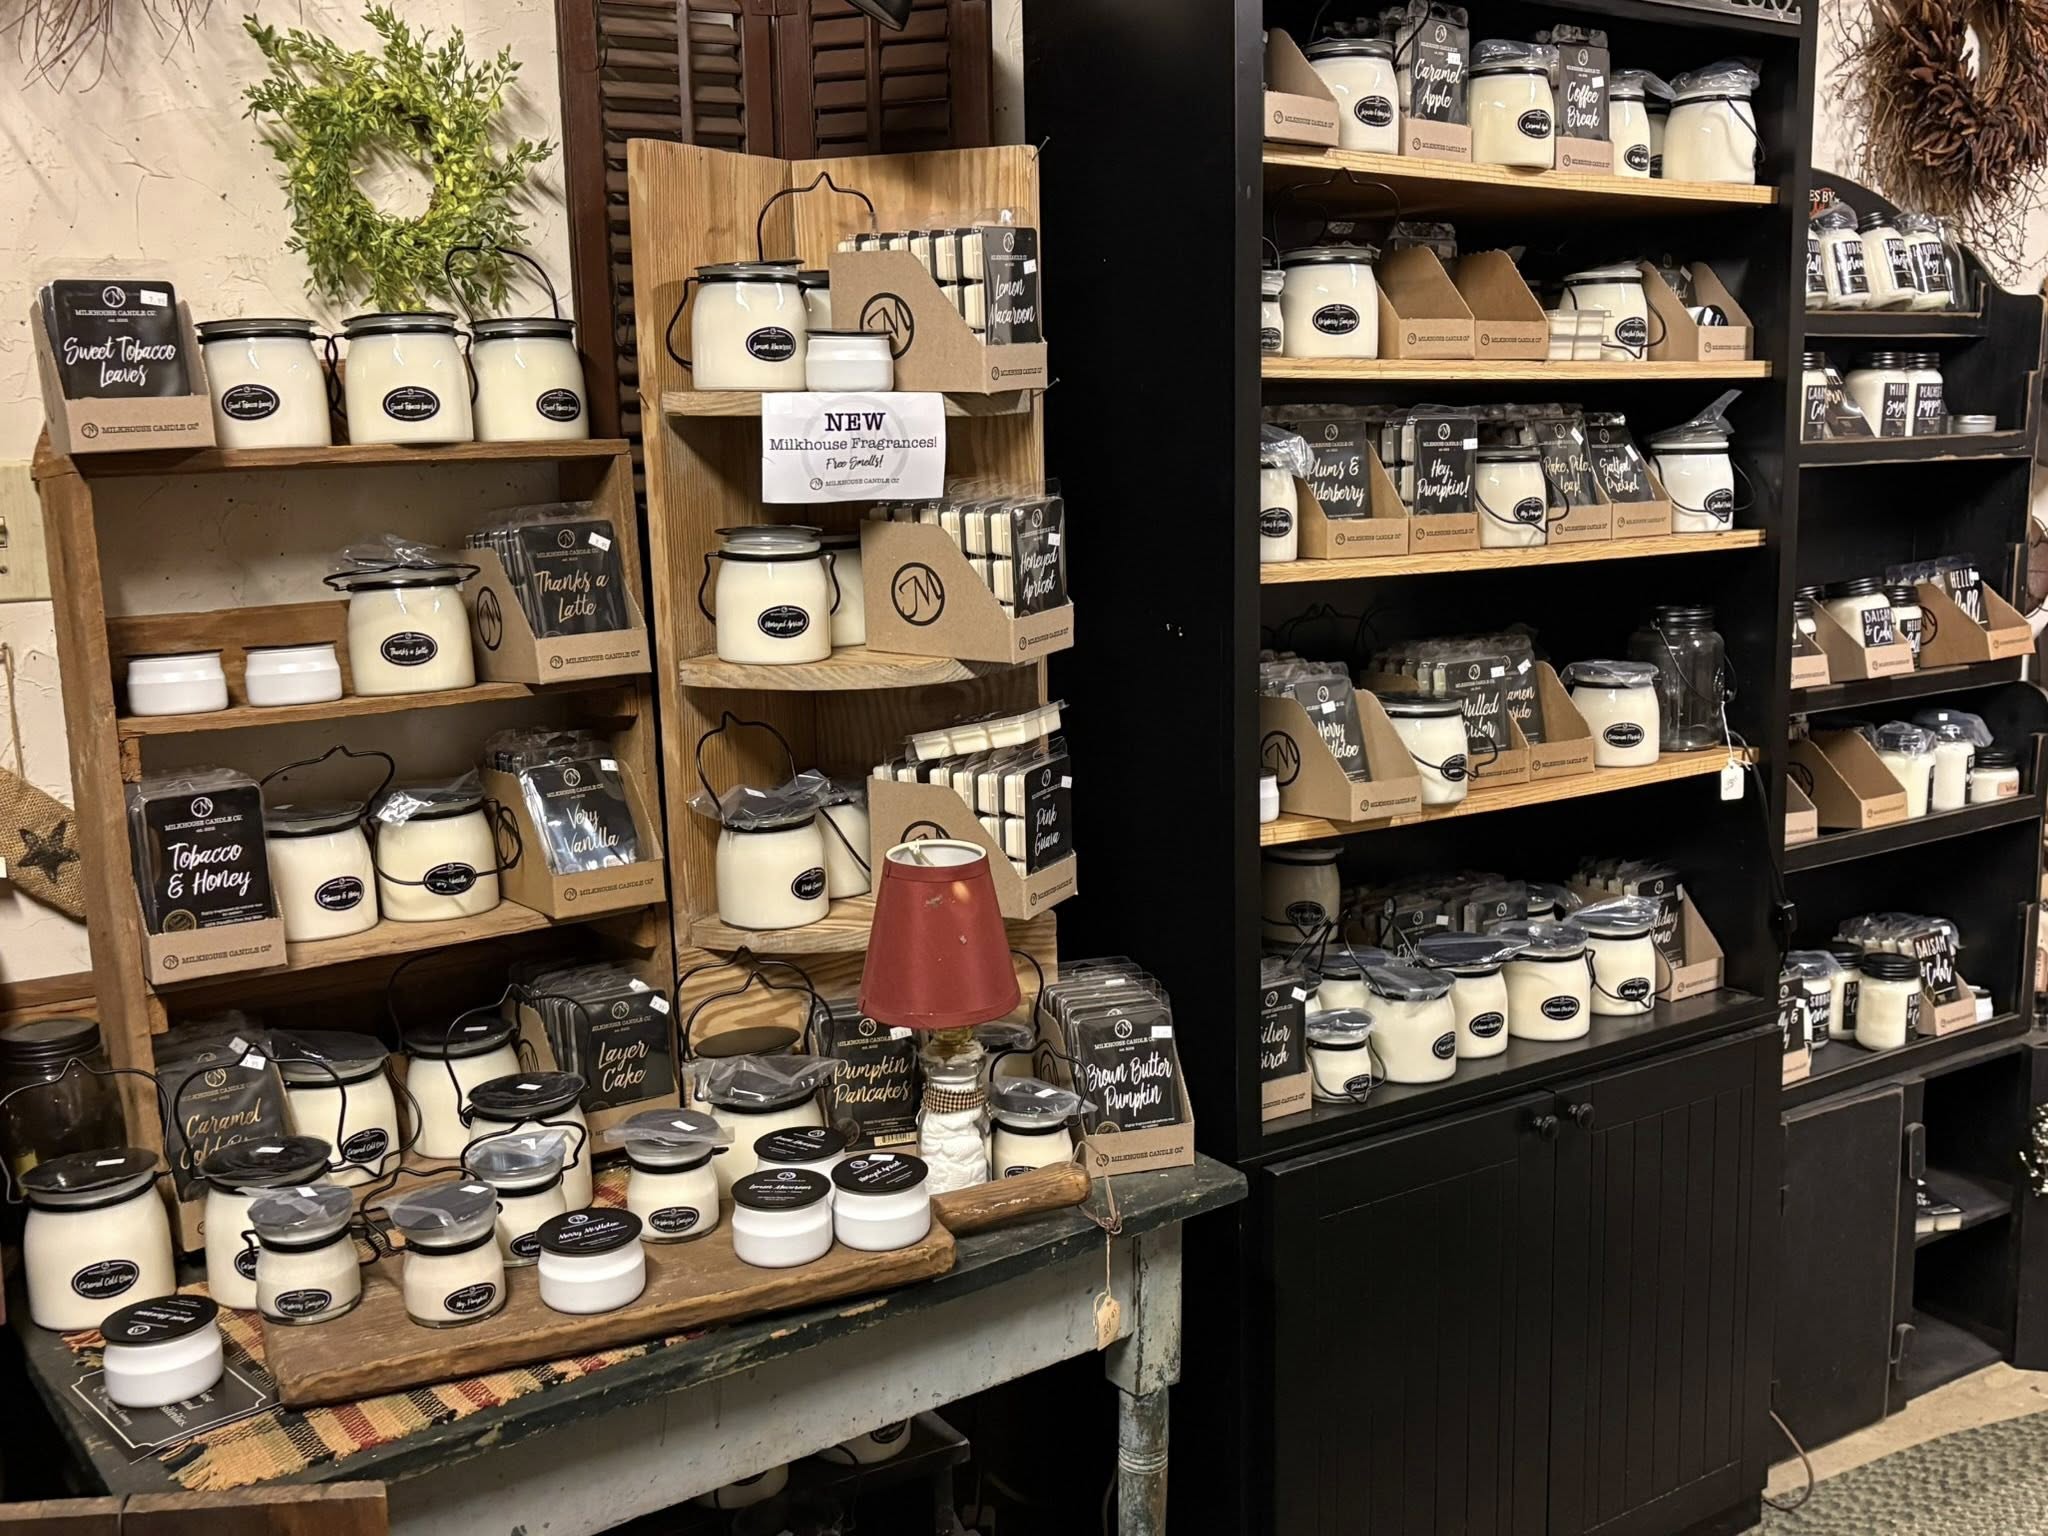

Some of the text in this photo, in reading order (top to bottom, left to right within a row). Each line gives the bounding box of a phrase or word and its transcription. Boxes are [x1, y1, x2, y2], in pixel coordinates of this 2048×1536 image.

[1414, 60, 1467, 85] Caramel
[1421, 87, 1452, 114] Apple
[1567, 80, 1599, 110] Coffee
[1567, 107, 1600, 128] Break
[1809, 189, 1821, 201] ES
[995, 273, 1025, 301] Lemon
[991, 303, 1036, 328] Macaroon
[64, 335, 177, 366] Sweet Tobacco
[100, 361, 149, 388] Leaves
[153, 425, 185, 433] CANDLE
[824, 411, 887, 432] NEW
[769, 435, 937, 452] Milkhouse Fragrances!
[825, 453, 884, 470] Free Smells!
[1349, 455, 1361, 477] &
[1432, 458, 1454, 482] Hey,
[1599, 454, 1631, 479] Salted
[1417, 474, 1471, 504] Pumpkin!
[1605, 476, 1640, 495] Pretzel
[534, 569, 610, 597] Thanks a
[1022, 568, 1056, 605] Apricot
[558, 596, 597, 624] Latte
[1506, 685, 1535, 703] amon
[164, 819, 205, 832] MILKHOUSE
[205, 816, 229, 827] CANDLE
[566, 803, 600, 830] Very
[564, 826, 620, 856] Vanilla
[167, 841, 243, 871] Tobacco
[167, 869, 252, 899] & Honey
[1652, 905, 1678, 932] liday
[182, 947, 261, 965] MILKHOUSE CANDLE
[1261, 1020, 1291, 1045] ilver
[598, 1040, 650, 1071] Layer
[602, 1063, 648, 1093] Cake
[833, 1055, 909, 1085] Pumpkin
[1086, 1050, 1174, 1092] Brown Butter
[832, 1079, 912, 1110] Pancakes
[1104, 1083, 1162, 1118] Pumpkin
[187, 1098, 264, 1140] Caramel
[1111, 1149, 1174, 1163] MILKHOUSE CANDLE
